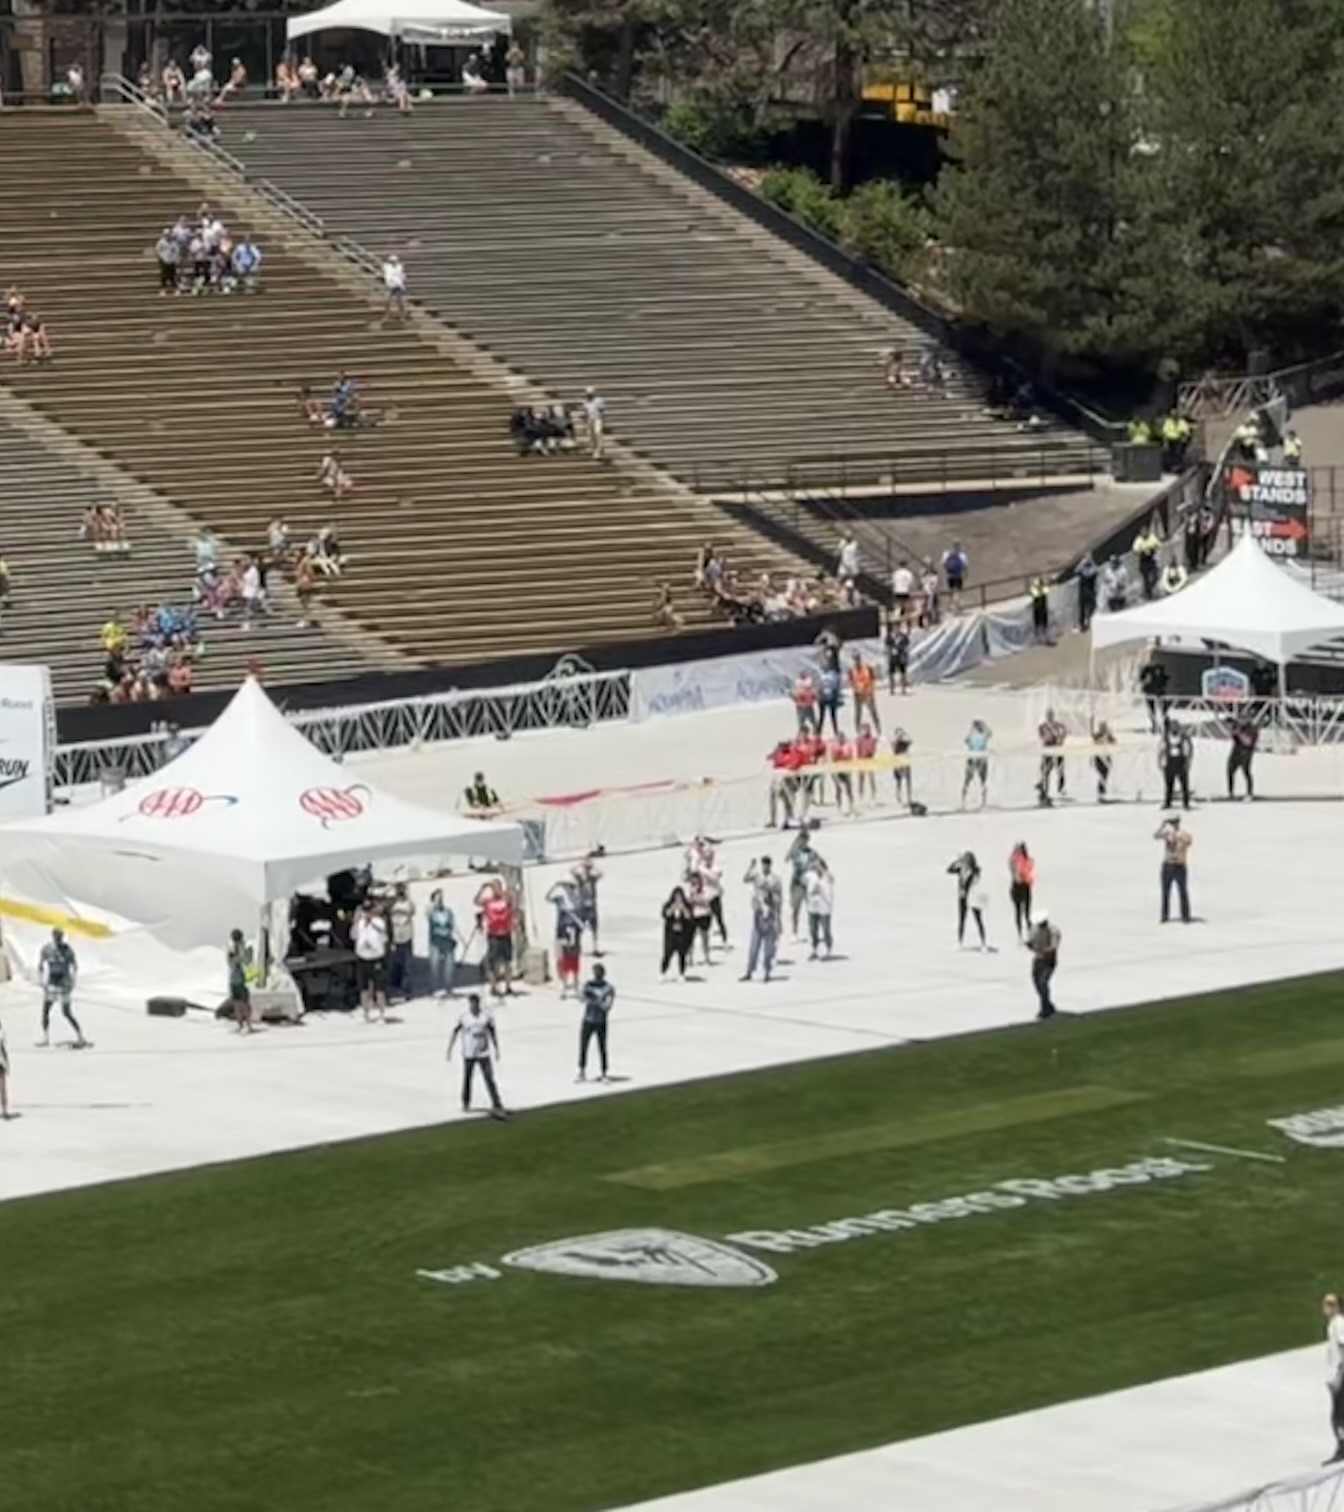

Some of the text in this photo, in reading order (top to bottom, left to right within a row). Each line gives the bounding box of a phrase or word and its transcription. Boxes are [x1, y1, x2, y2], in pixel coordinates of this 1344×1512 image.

[1257, 470, 1306, 487] WEST
[1239, 484, 1306, 504] STANDS
[1231, 519, 1272, 537] EST
[416, 1157, 1213, 1283] by Runners Roost
